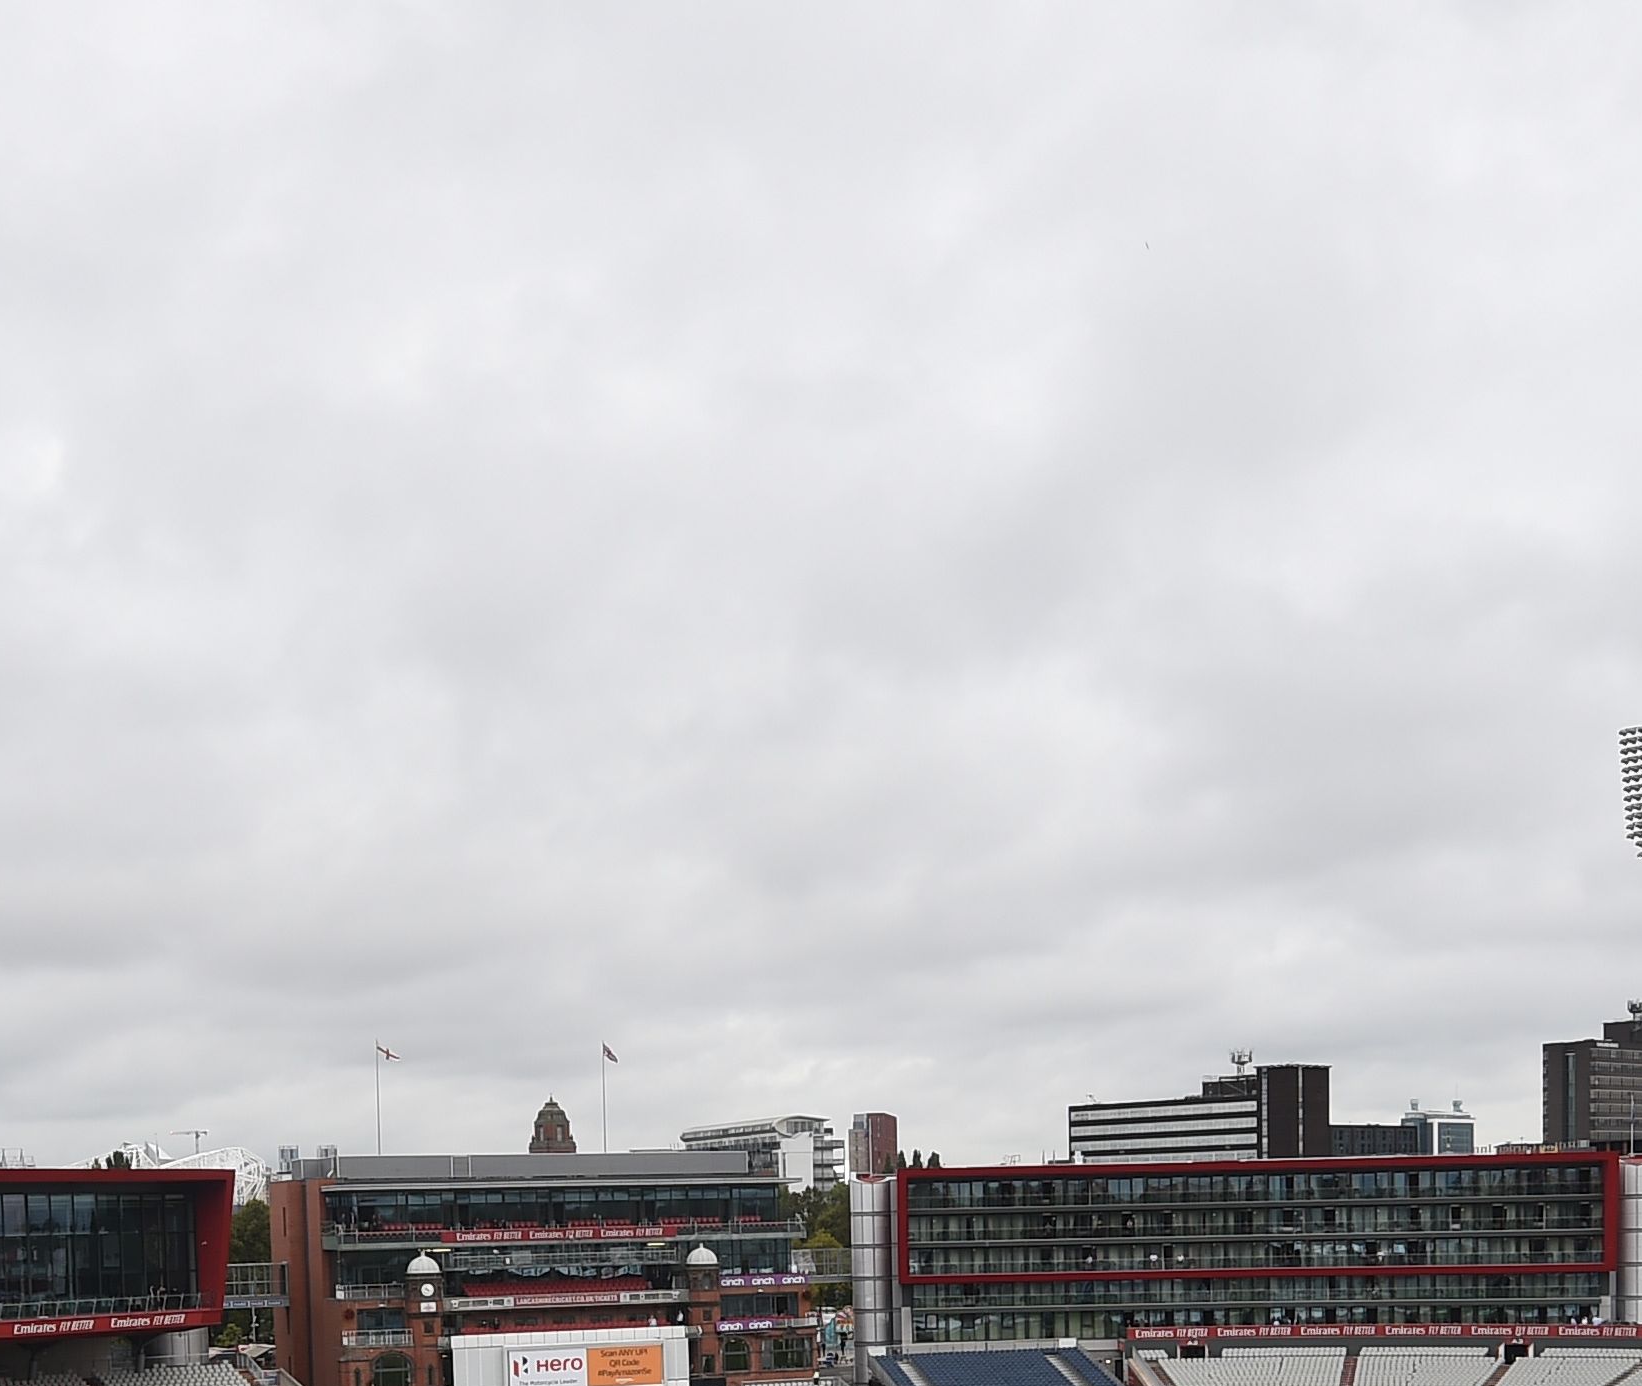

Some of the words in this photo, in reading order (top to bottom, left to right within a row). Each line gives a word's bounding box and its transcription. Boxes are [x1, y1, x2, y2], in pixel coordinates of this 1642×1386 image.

[721, 1278, 744, 1286] cinch
[752, 1277, 775, 1285] cinch
[782, 1276, 805, 1284] cinch
[516, 1295, 618, 1305] LANCASHIRECRICKET.CO.UK/TICKETS
[13, 1323, 56, 1335] Emirates
[59, 1321, 71, 1332] FLY
[72, 1320, 94, 1331] BETTER
[719, 1322, 743, 1331] cinch
[749, 1320, 772, 1329] cinch
[1217, 1328, 1256, 1337] Emirates
[1301, 1327, 1340, 1336] Emirates
[1385, 1326, 1425, 1335] Emirates
[1471, 1327, 1512, 1335] Emirates
[1558, 1327, 1600, 1336] Emirates
[609, 1359, 620, 1367] QR
